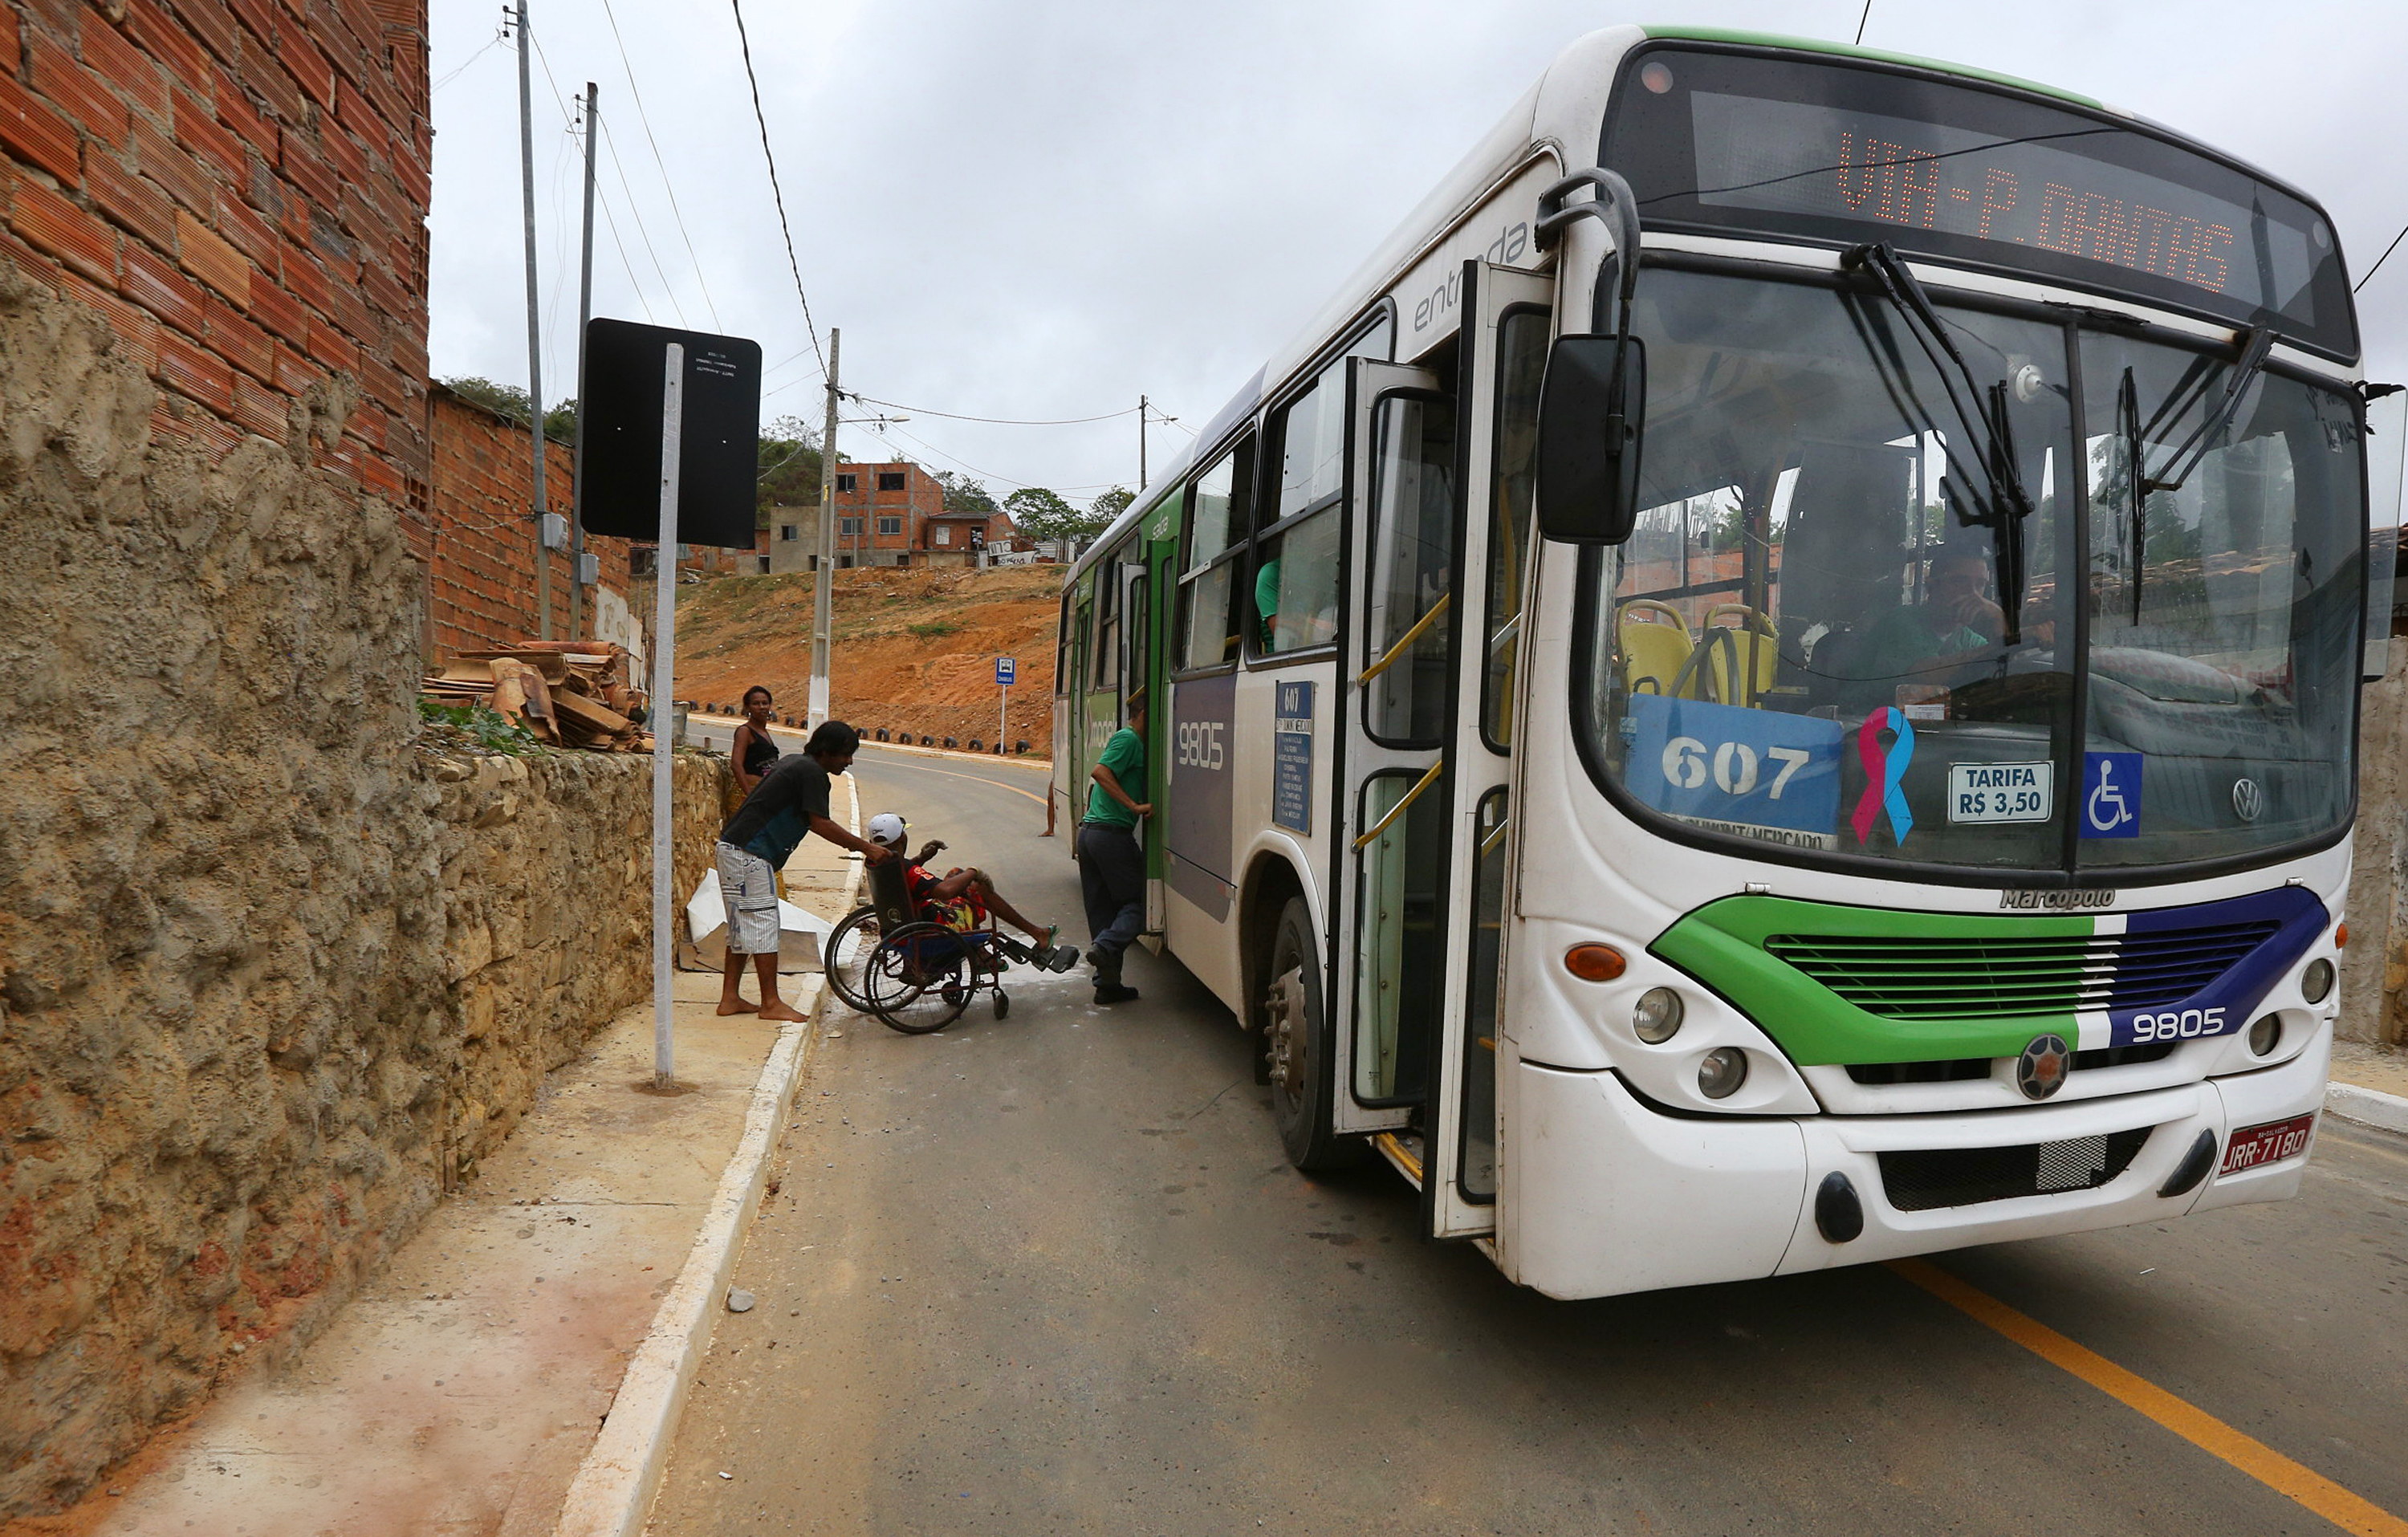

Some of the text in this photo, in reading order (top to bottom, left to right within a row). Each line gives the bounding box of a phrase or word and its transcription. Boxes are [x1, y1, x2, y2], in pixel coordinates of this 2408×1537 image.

[1413, 222, 1528, 332] entrda
[1285, 688, 1299, 713] 607
[1091, 712, 1117, 748] model
[1179, 722, 1224, 771] 9805
[1662, 737, 1809, 799] 607
[1967, 768, 2036, 788] TARIFA
[1960, 791, 2041, 815] R$ 3,50
[1999, 888, 2116, 909] Marcopolo
[2132, 1006, 2227, 1043] 9805
